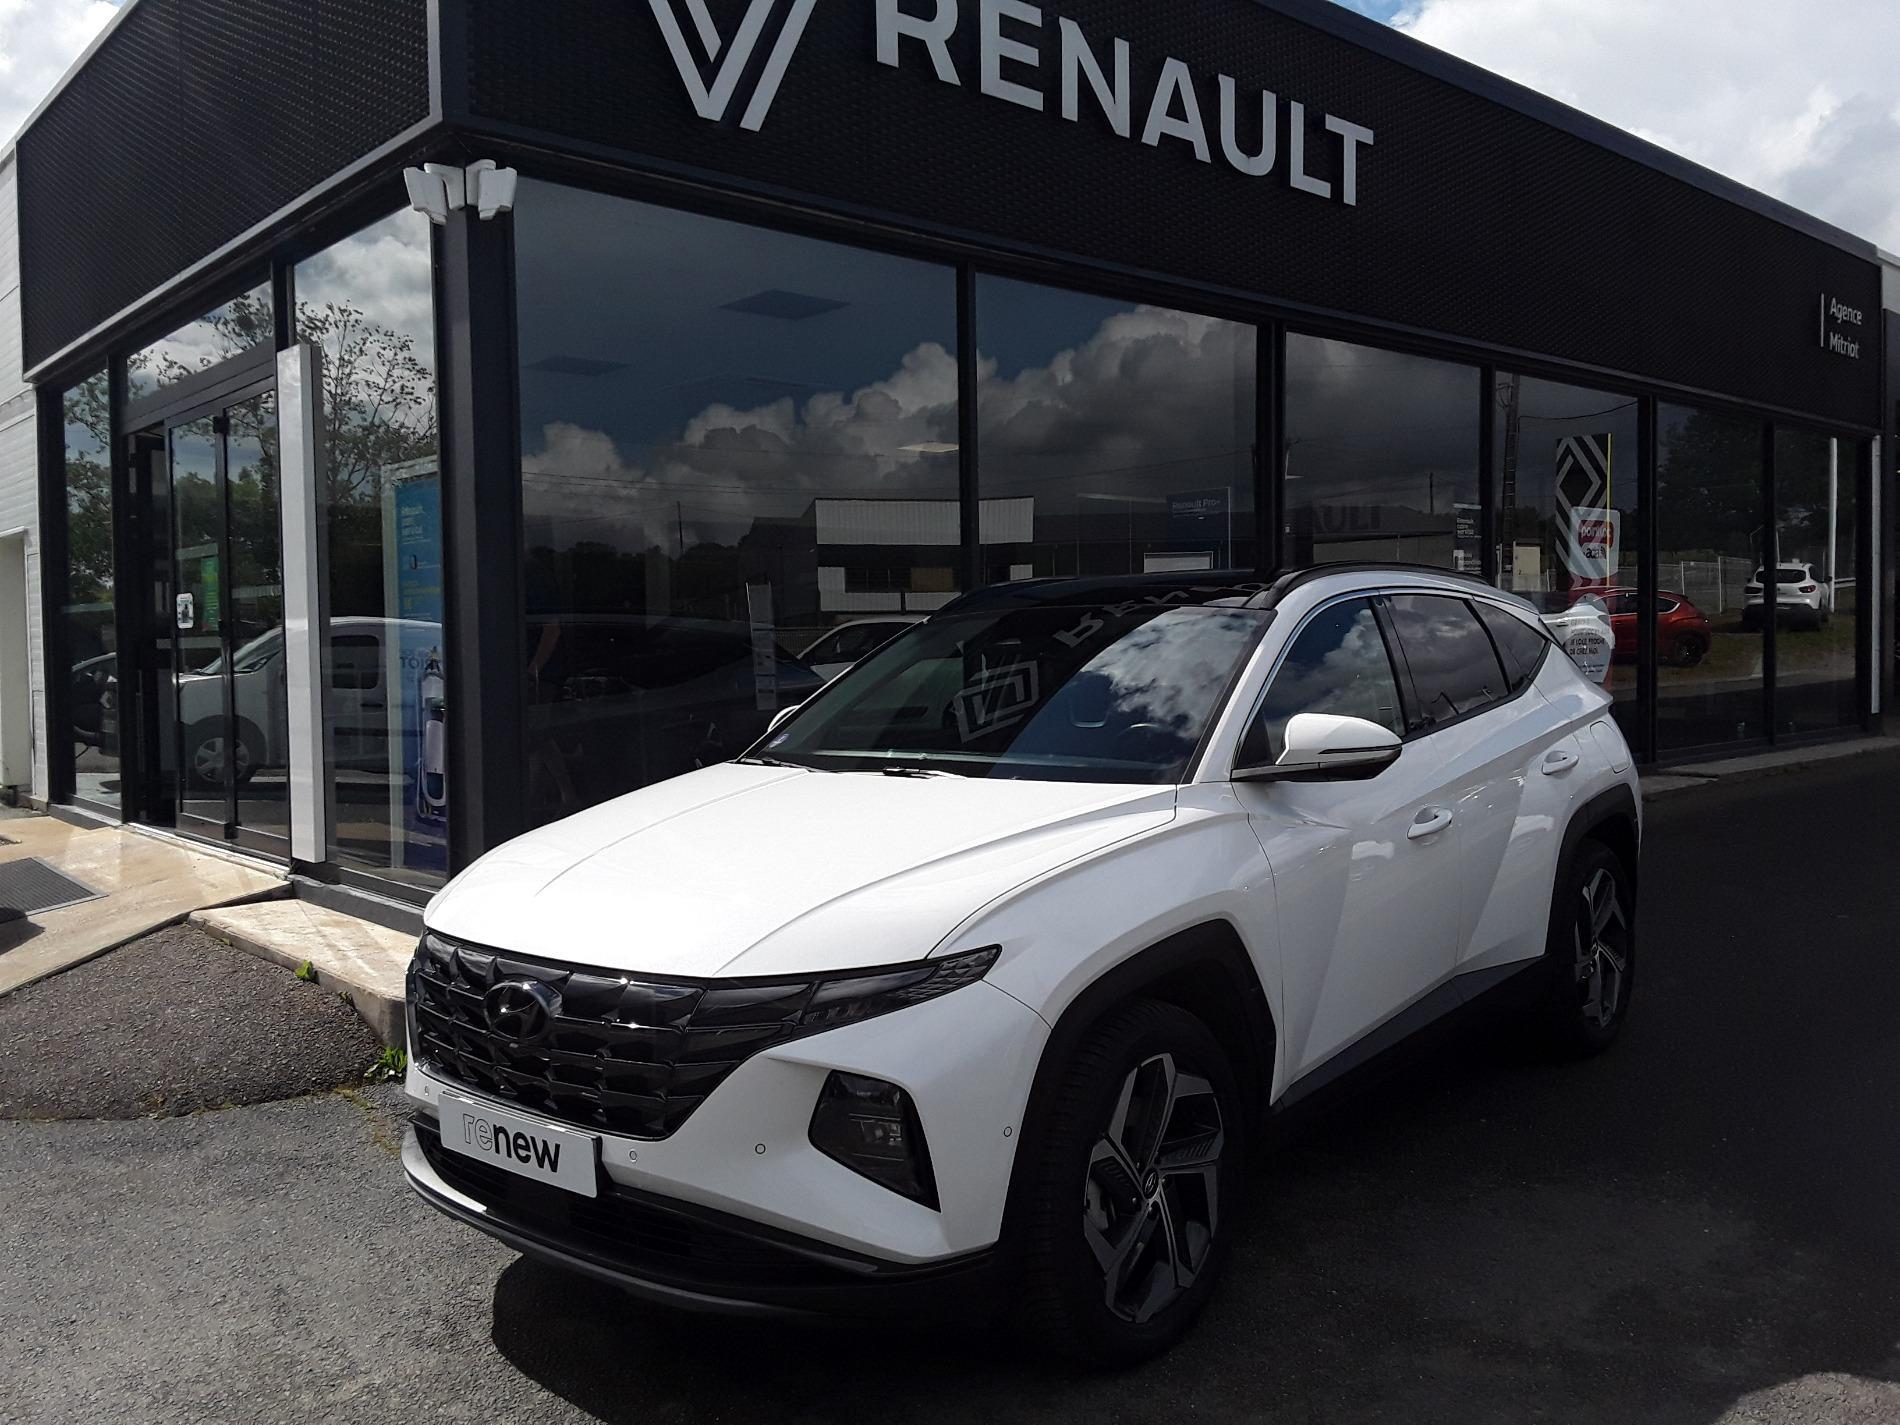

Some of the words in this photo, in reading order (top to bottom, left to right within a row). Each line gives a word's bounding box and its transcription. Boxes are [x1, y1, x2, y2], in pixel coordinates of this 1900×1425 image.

[875, 0, 1375, 206] RENAULT
[1829, 297, 1863, 325] Agence
[1829, 331, 1860, 359] Mitriot
[463, 1113, 561, 1173] renew
